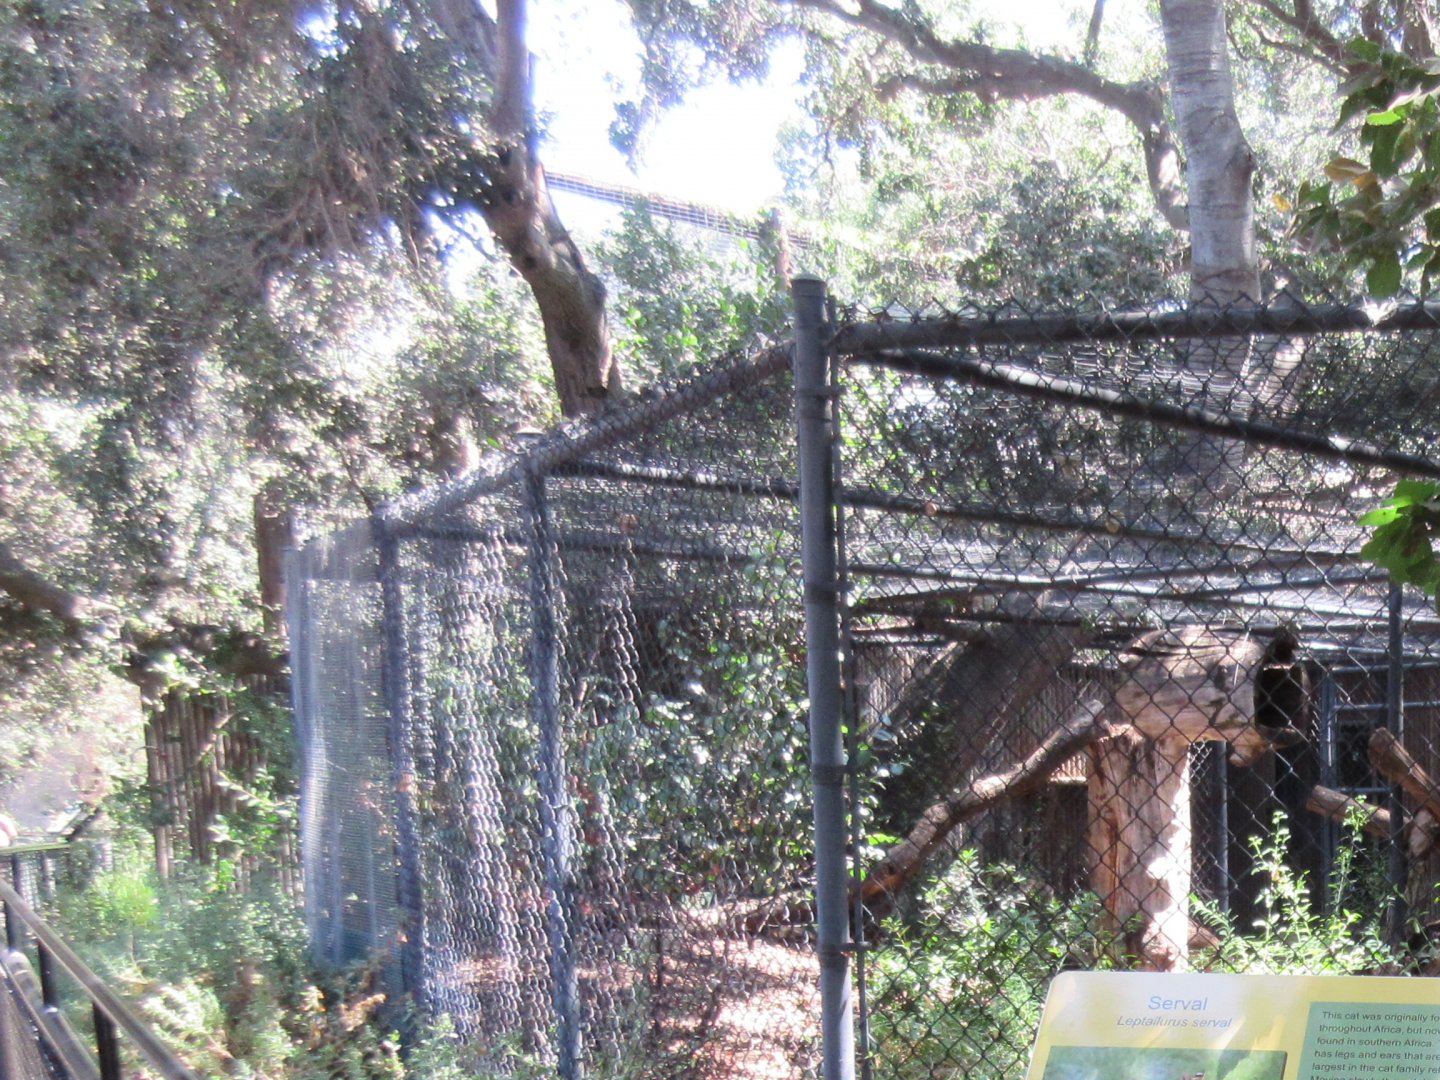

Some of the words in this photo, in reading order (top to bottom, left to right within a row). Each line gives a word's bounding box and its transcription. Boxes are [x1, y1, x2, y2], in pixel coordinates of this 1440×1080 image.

[1147, 995, 1208, 1011] Serval
[1117, 1015, 1187, 1028] Leptailurus
[1192, 1017, 1232, 1028] serval
[1322, 1010, 1343, 1019] This
[1344, 1011, 1360, 1020] cat
[1384, 1012, 1429, 1023] originally
[1319, 1023, 1372, 1034] throughout
[1406, 1025, 1423, 1034] but
[1316, 1035, 1345, 1045] found
[1346, 1036, 1357, 1045] in
[1358, 1037, 1402, 1046] southern
[1314, 1048, 1333, 1057] has
[1334, 1049, 1356, 1060] legs
[1357, 1050, 1377, 1059] and
[1403, 1051, 1424, 1060] that
[1311, 1061, 1346, 1072] largest
[1347, 1062, 1358, 1071] in
[1359, 1063, 1376, 1072] the
[1377, 1064, 1394, 1072] cat
[1395, 1064, 1426, 1075] family
